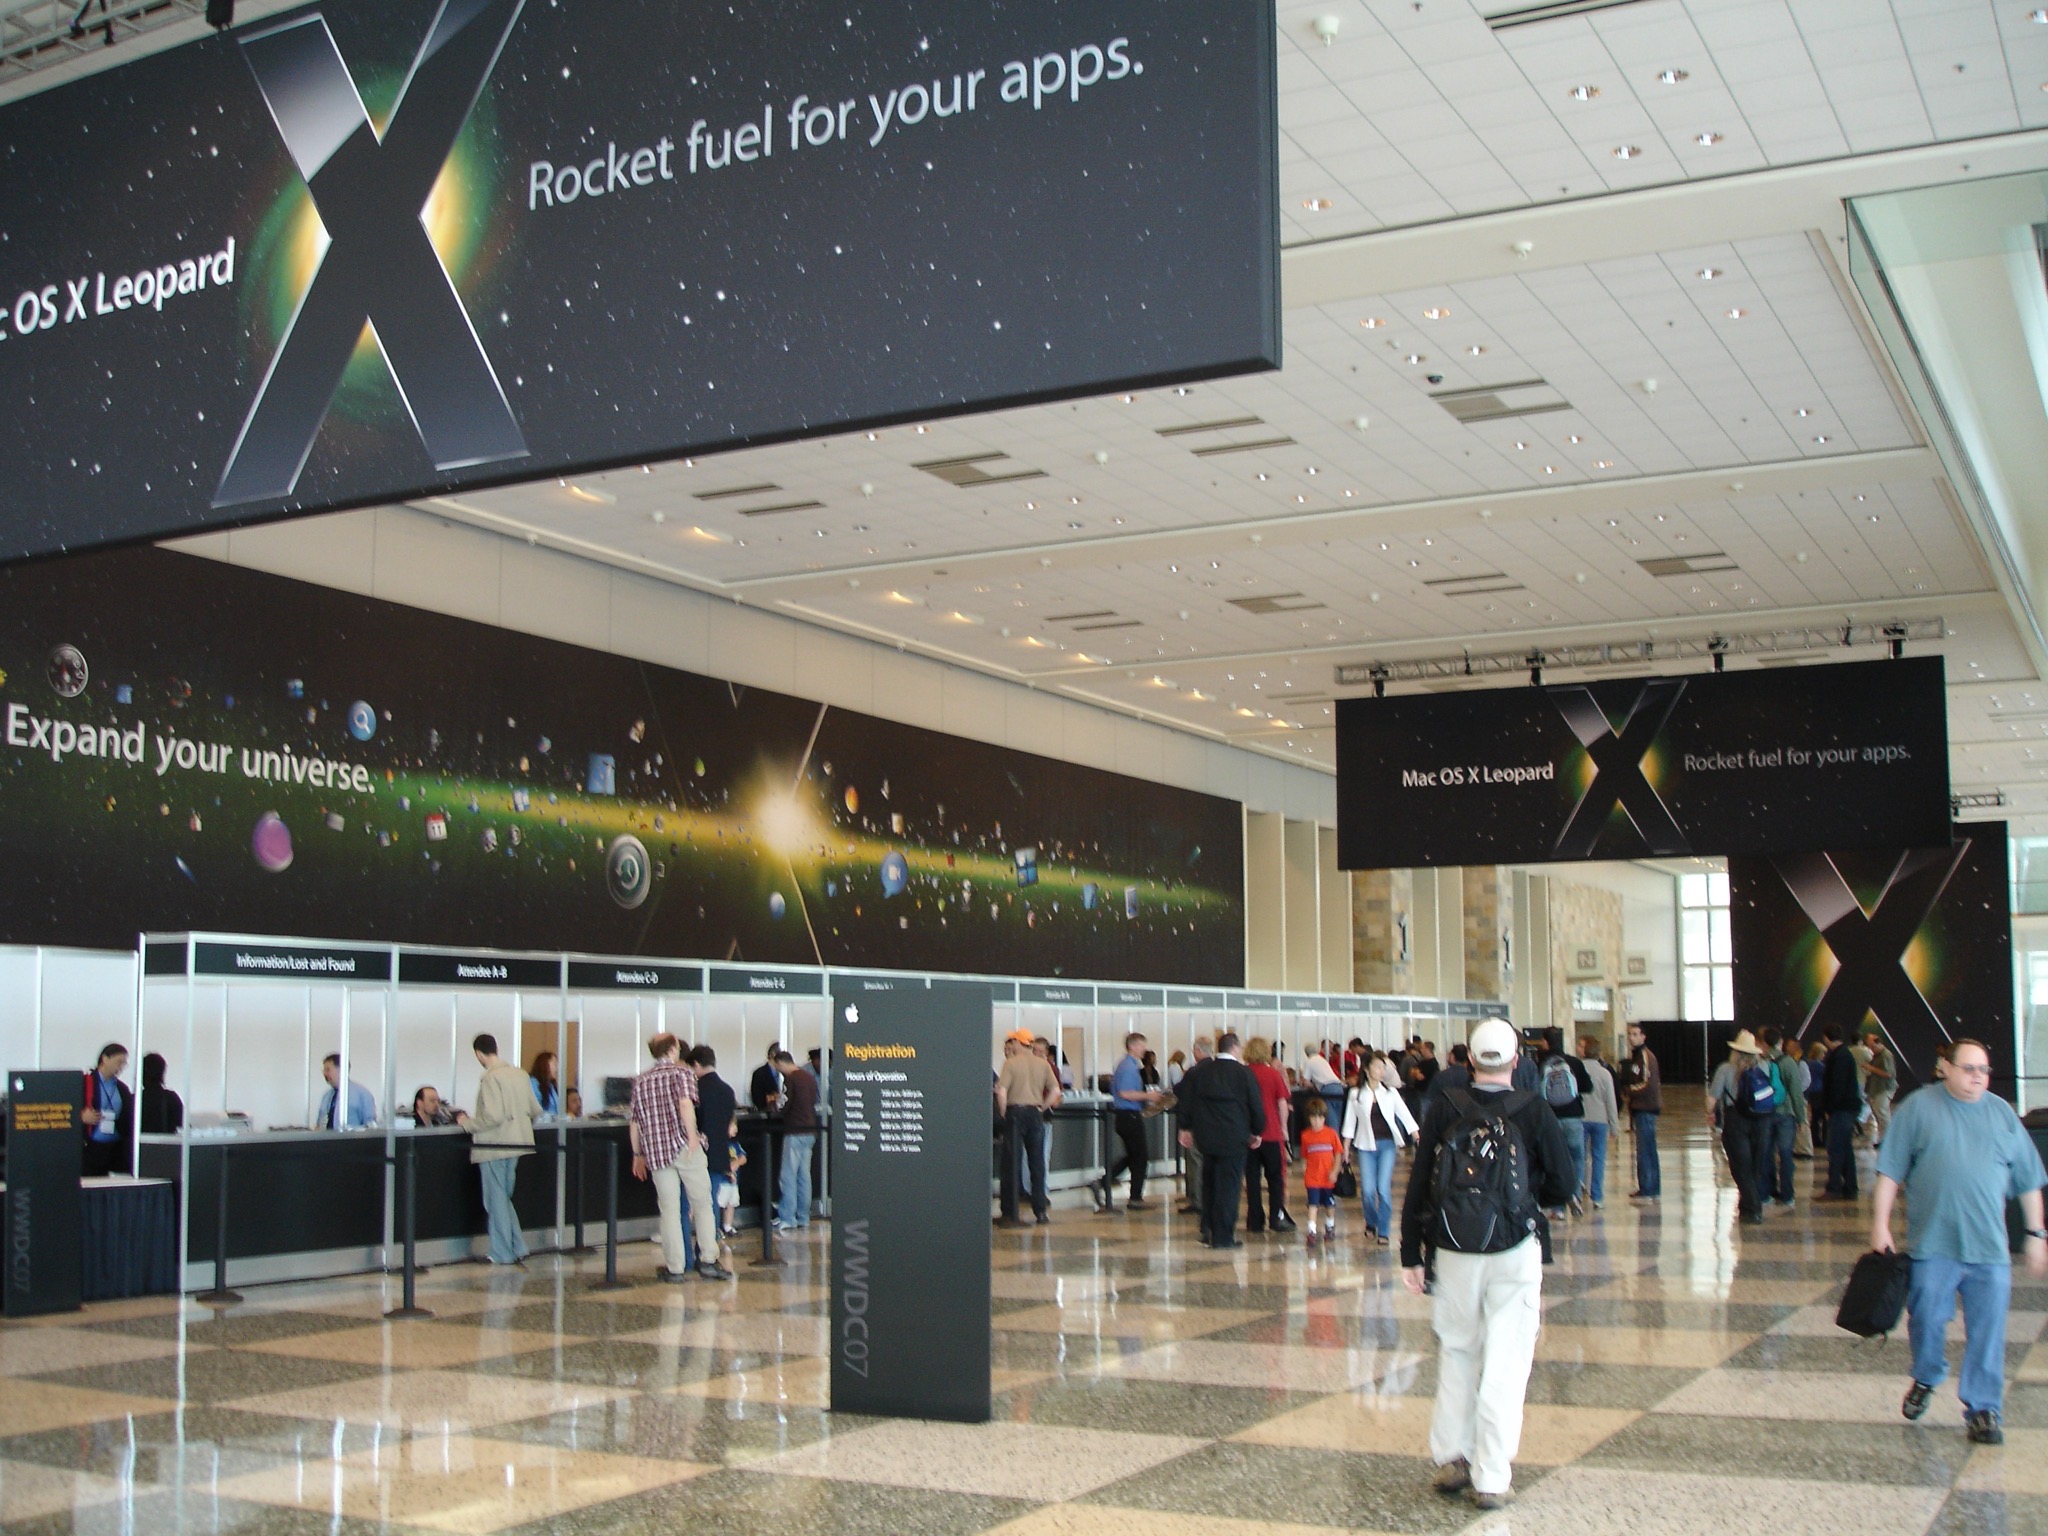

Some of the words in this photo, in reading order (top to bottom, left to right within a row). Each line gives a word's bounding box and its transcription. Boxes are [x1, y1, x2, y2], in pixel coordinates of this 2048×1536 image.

[527, 138, 677, 212] Rocket
[685, 103, 775, 174] fuel
[787, 95, 856, 151] for
[867, 68, 987, 148] your
[999, 36, 1145, 111] apps.
[13, 284, 60, 335] OS
[63, 277, 90, 323] X
[95, 235, 237, 314] Leopard
[6, 702, 147, 764] Expand
[155, 734, 234, 777] your
[241, 743, 377, 794] universe.
[1684, 752, 1745, 772] Rocket
[1748, 748, 1783, 767] fuel
[1786, 746, 1813, 766] for
[1816, 748, 1859, 769] your
[1861, 744, 1912, 765] apps.
[1402, 768, 1437, 788] Mac
[1439, 767, 1465, 786] OS
[1467, 766, 1480, 784] X
[1482, 761, 1555, 786] Leopard
[235, 952, 309, 971] Information/Lost
[309, 955, 327, 972] and
[328, 956, 356, 972] Found
[457, 963, 492, 978] Attendee
[844, 1042, 917, 1062] Registration
[844, 1070, 866, 1082] Hours
[865, 1070, 874, 1082] of
[874, 1070, 908, 1083] Operation
[12, 1188, 32, 1293] WWDC07
[843, 1217, 870, 1379] WWDC07
